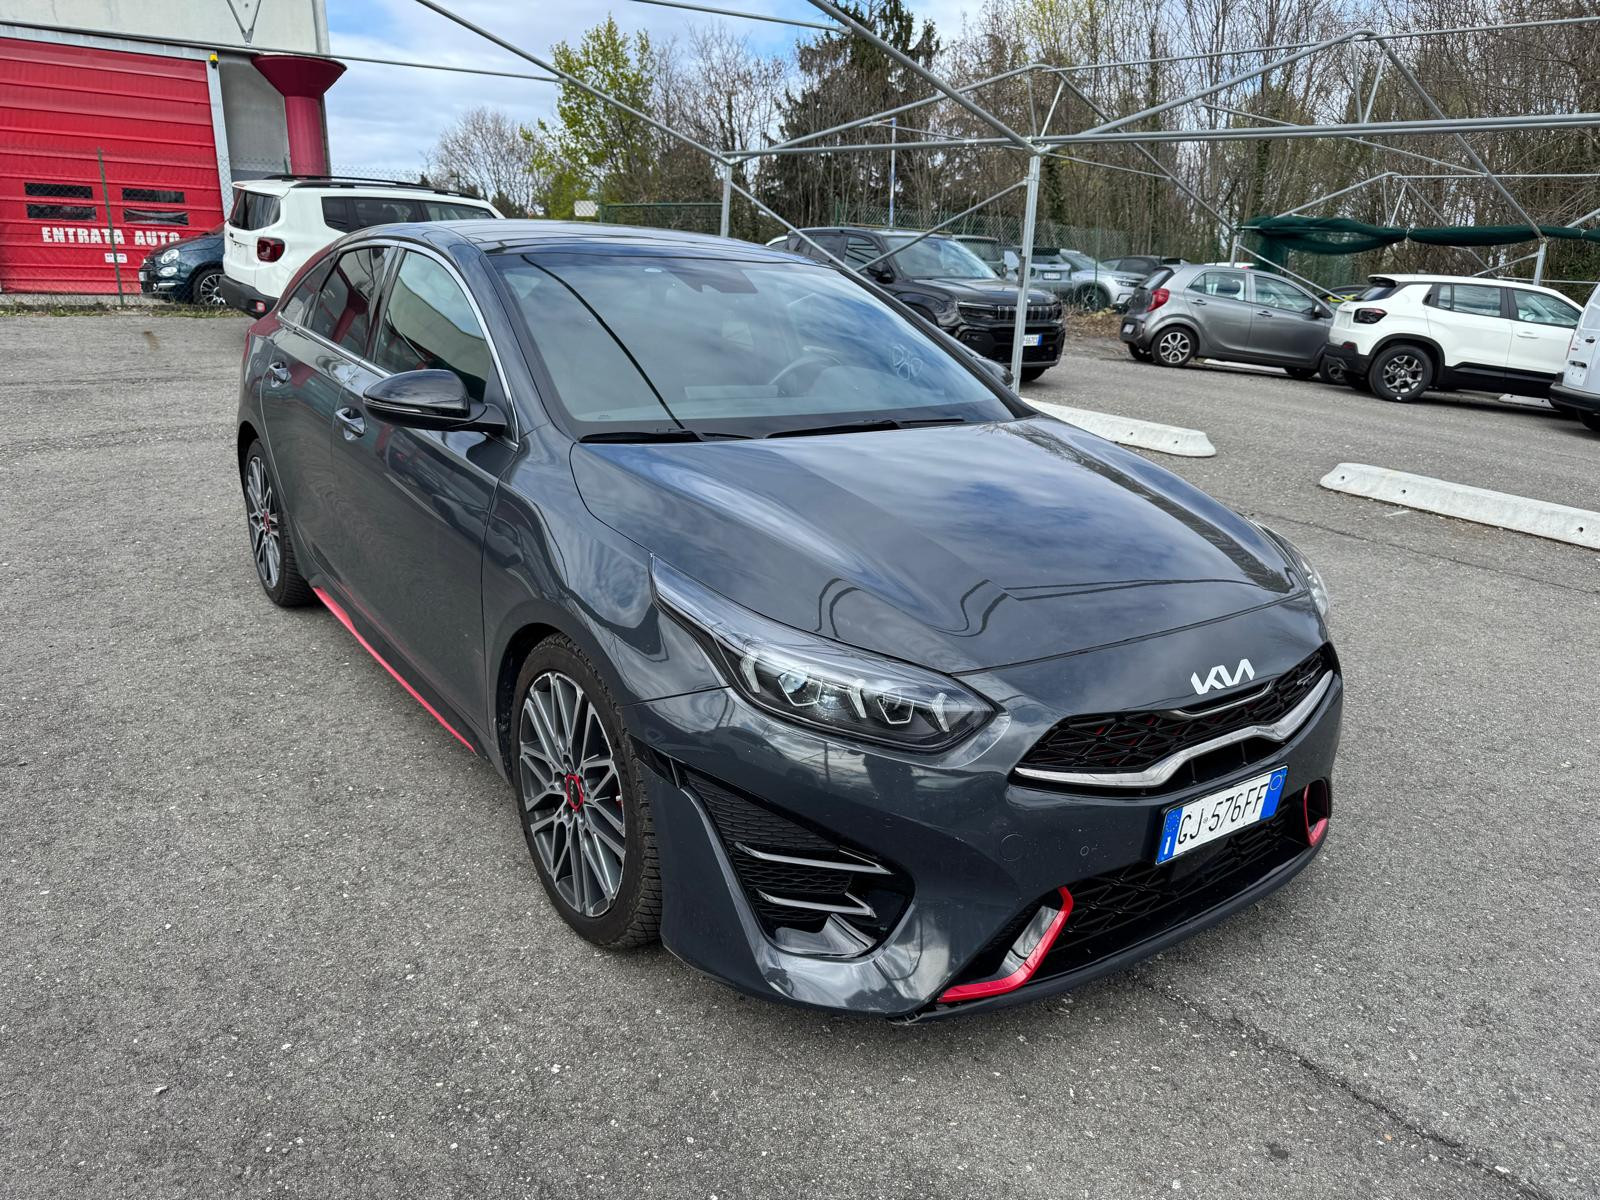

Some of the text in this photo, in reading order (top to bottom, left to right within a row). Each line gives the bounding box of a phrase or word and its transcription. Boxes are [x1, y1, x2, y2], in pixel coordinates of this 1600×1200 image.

[42, 227, 180, 246] ENTRATA AUTO
[1191, 659, 1255, 695] KIA
[1178, 783, 1268, 844] GJ 576FF
